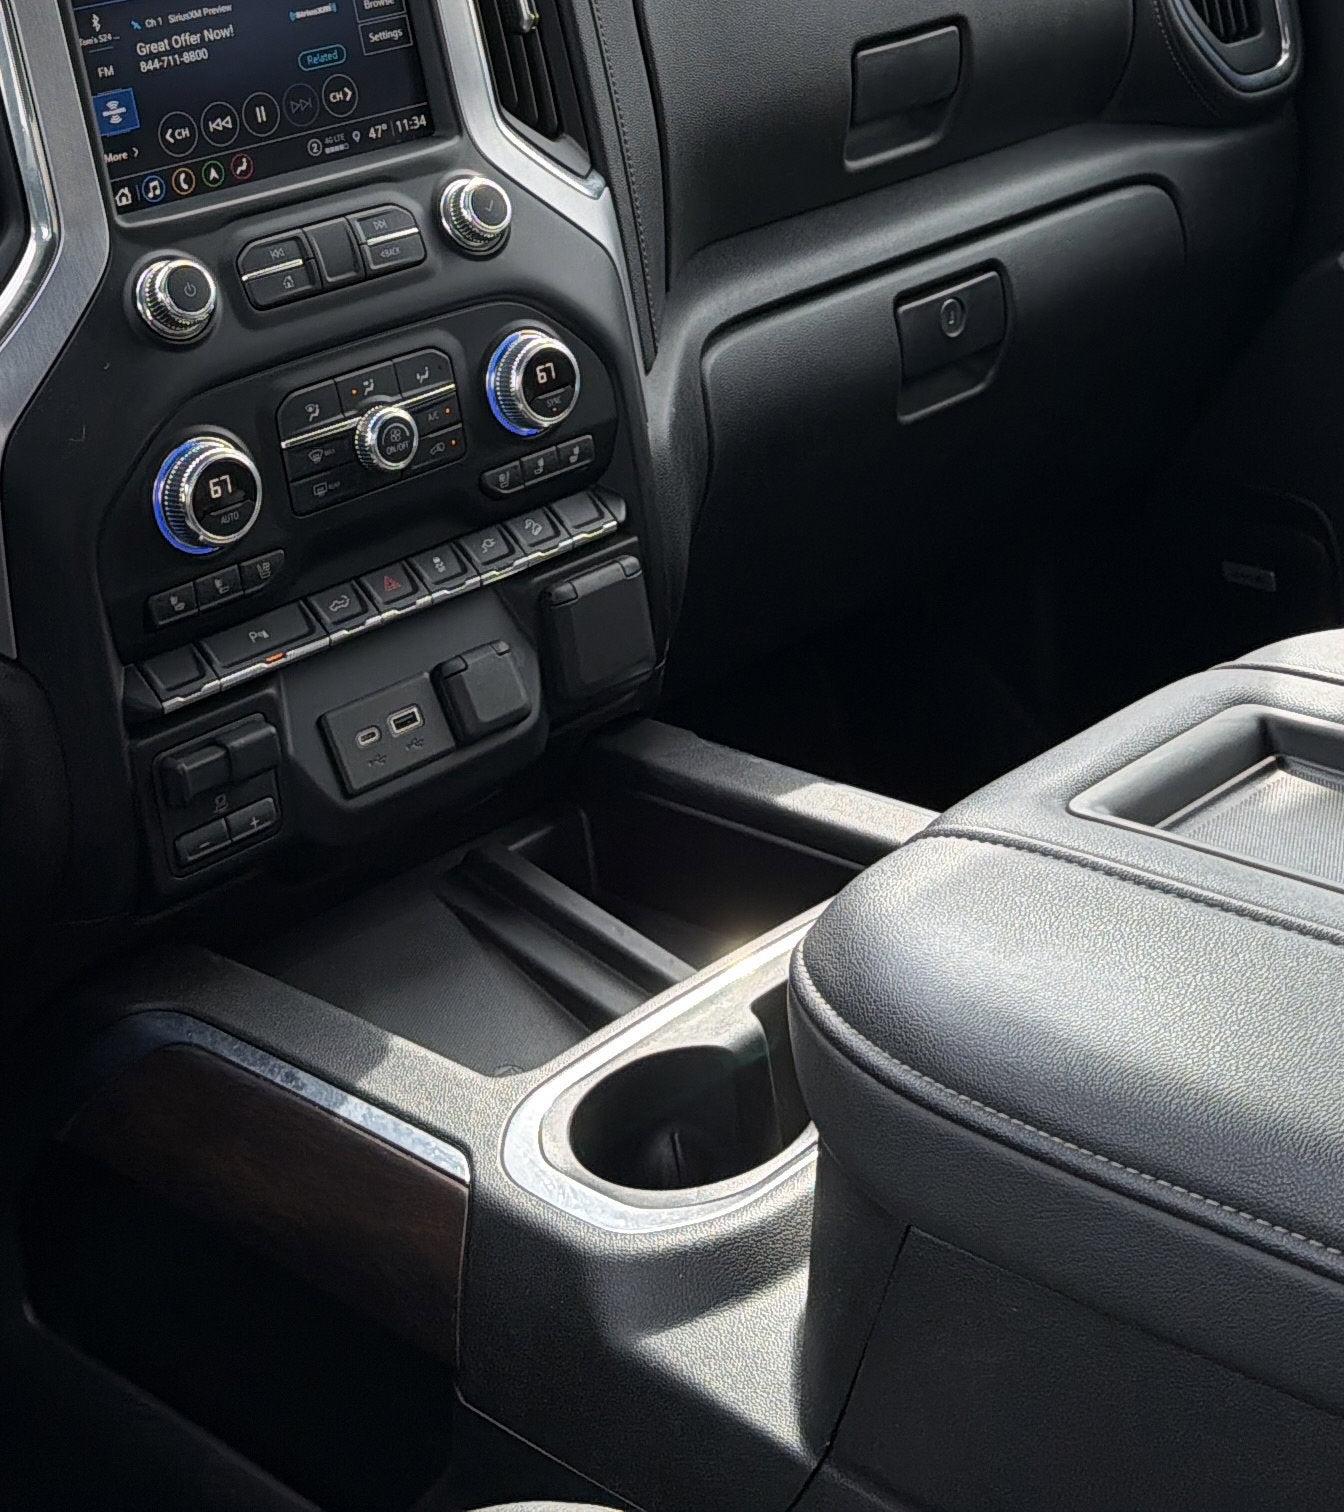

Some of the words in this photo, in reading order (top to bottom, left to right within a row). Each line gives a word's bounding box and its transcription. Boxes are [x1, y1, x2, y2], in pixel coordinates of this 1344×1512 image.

[145, 18, 156, 28] Ch
[168, 11, 202, 24] SiriusXM
[203, 4, 233, 18] Preview
[136, 38, 169, 56] Great
[171, 31, 202, 49] Offer
[203, 24, 234, 43] Now!
[369, 28, 403, 43] Settings
[139, 48, 209, 73] 844-711-8800
[307, 50, 339, 66] Related
[98, 65, 114, 78] FM
[329, 91, 343, 103] CH
[396, 114, 427, 134] 11:34
[175, 127, 190, 139] CH
[105, 151, 128, 163] More
[536, 362, 556, 384] 67
[386, 441, 410, 455] ON/OFF
[209, 474, 232, 498] 67
[221, 511, 239, 524] AUTO
